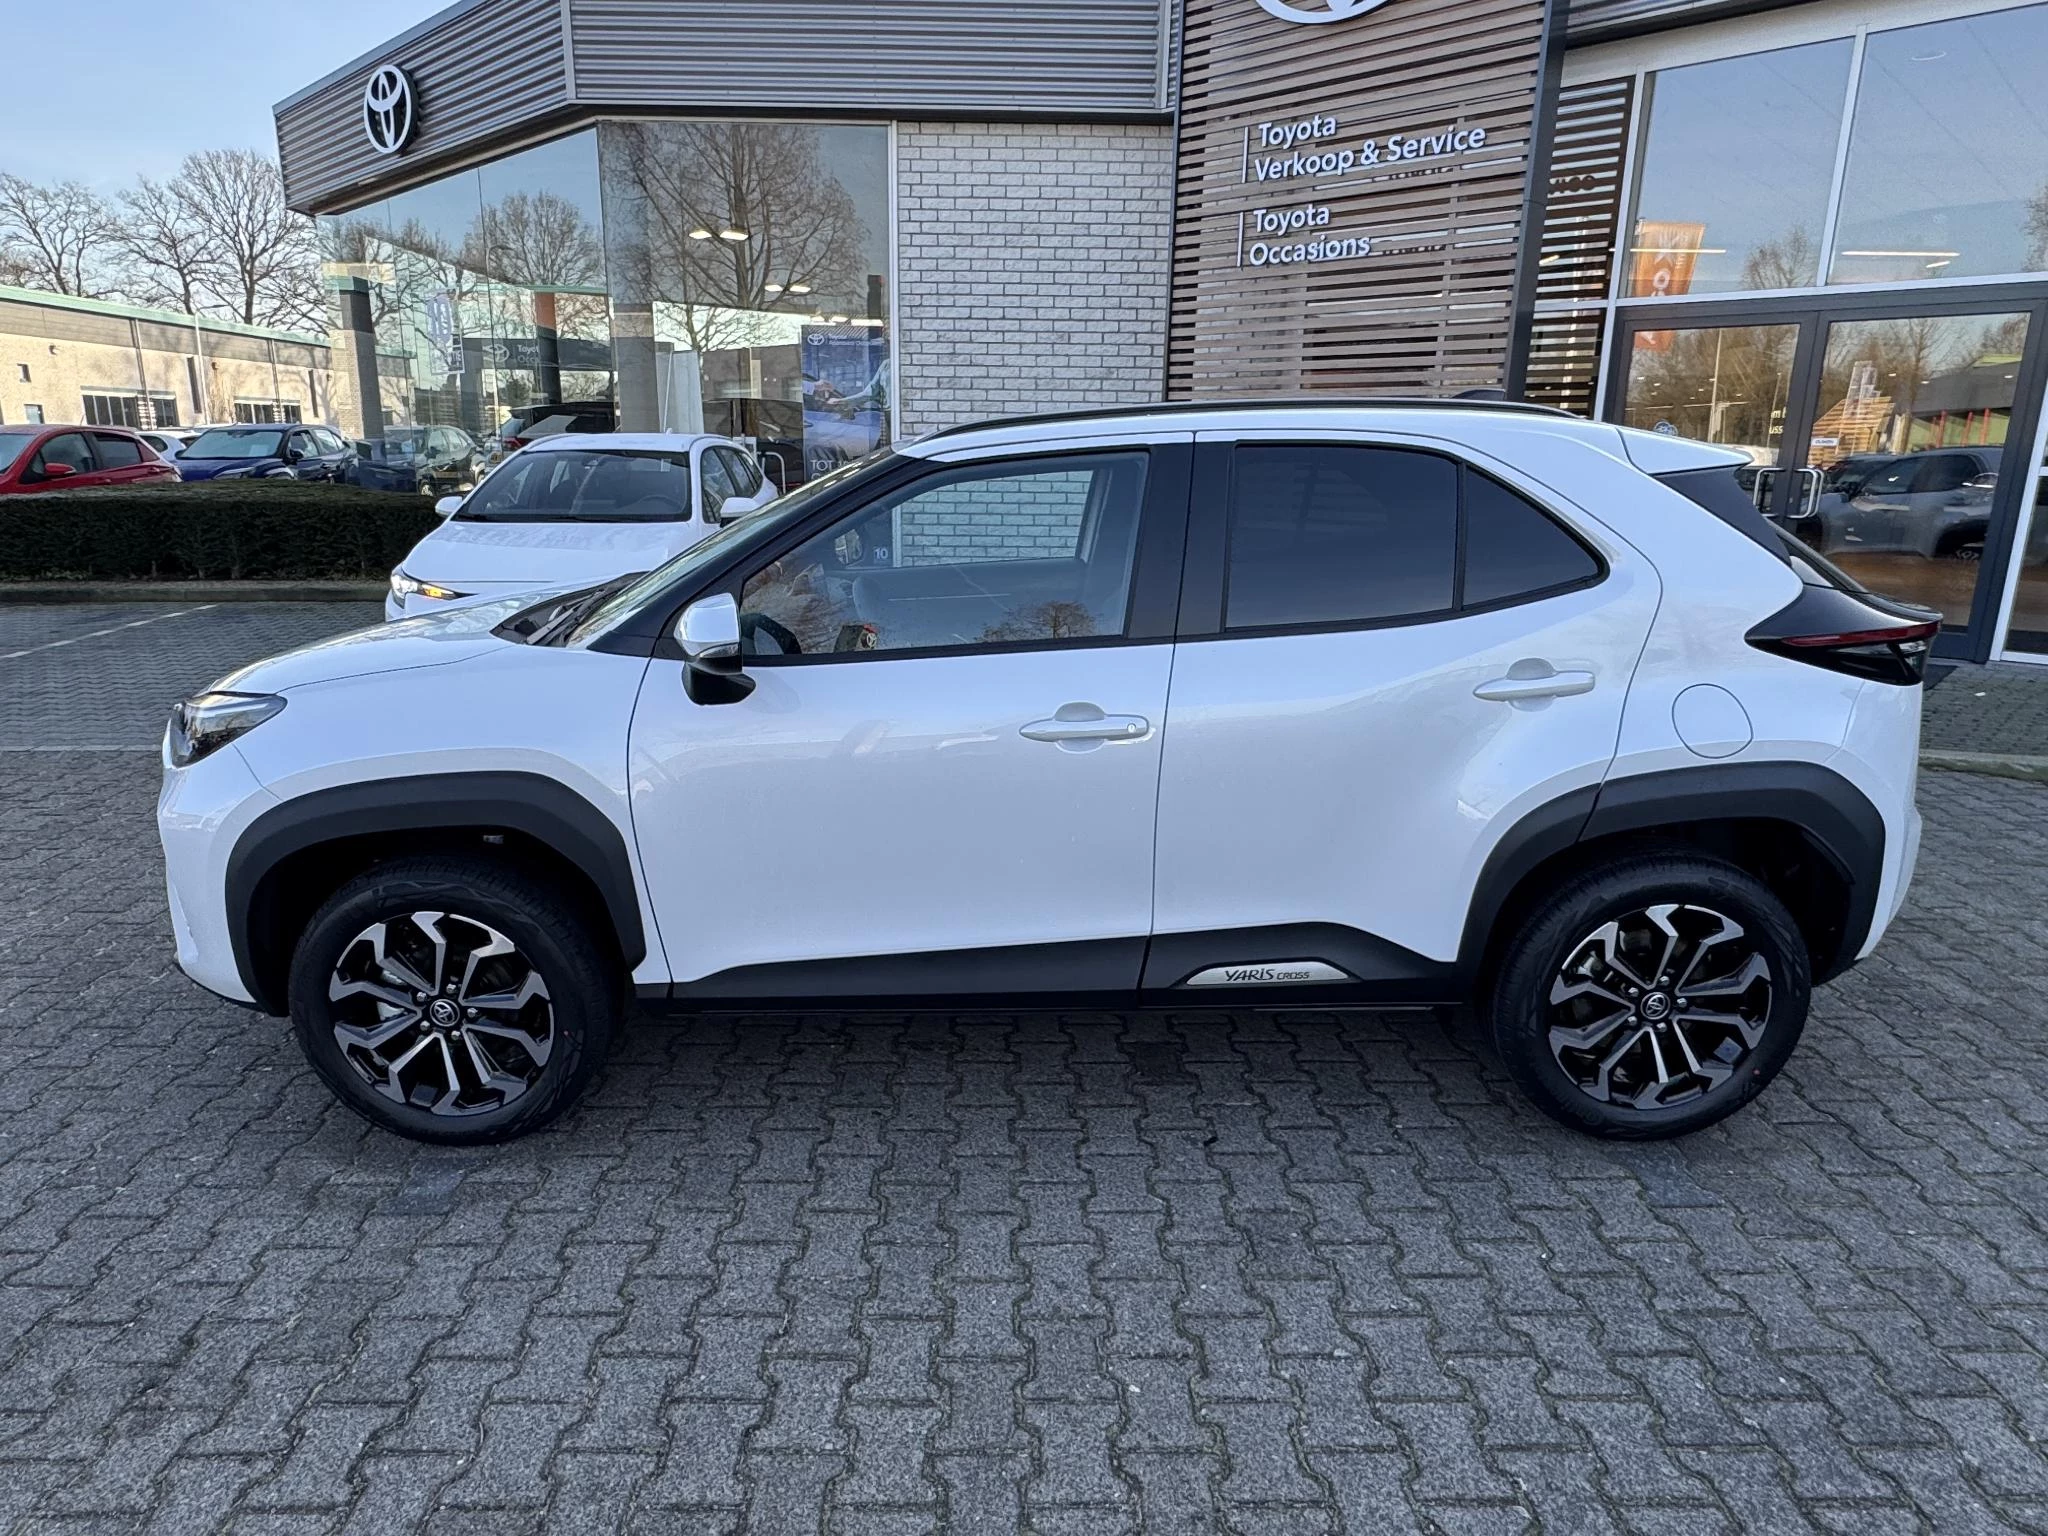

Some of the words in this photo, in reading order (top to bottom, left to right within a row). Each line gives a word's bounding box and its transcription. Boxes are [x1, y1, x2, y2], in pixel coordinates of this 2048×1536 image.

[1258, 114, 1337, 149] Toyota
[1254, 150, 1355, 181] Verkoop
[1360, 139, 1380, 165] &
[1387, 125, 1487, 161] Service
[1253, 204, 1330, 236] Toyota
[1249, 234, 1371, 266] Occasions
[810, 459, 834, 471] TOT
[874, 547, 889, 559] 10
[1225, 968, 1275, 981] YARIS
[1276, 972, 1310, 980] CROSS
